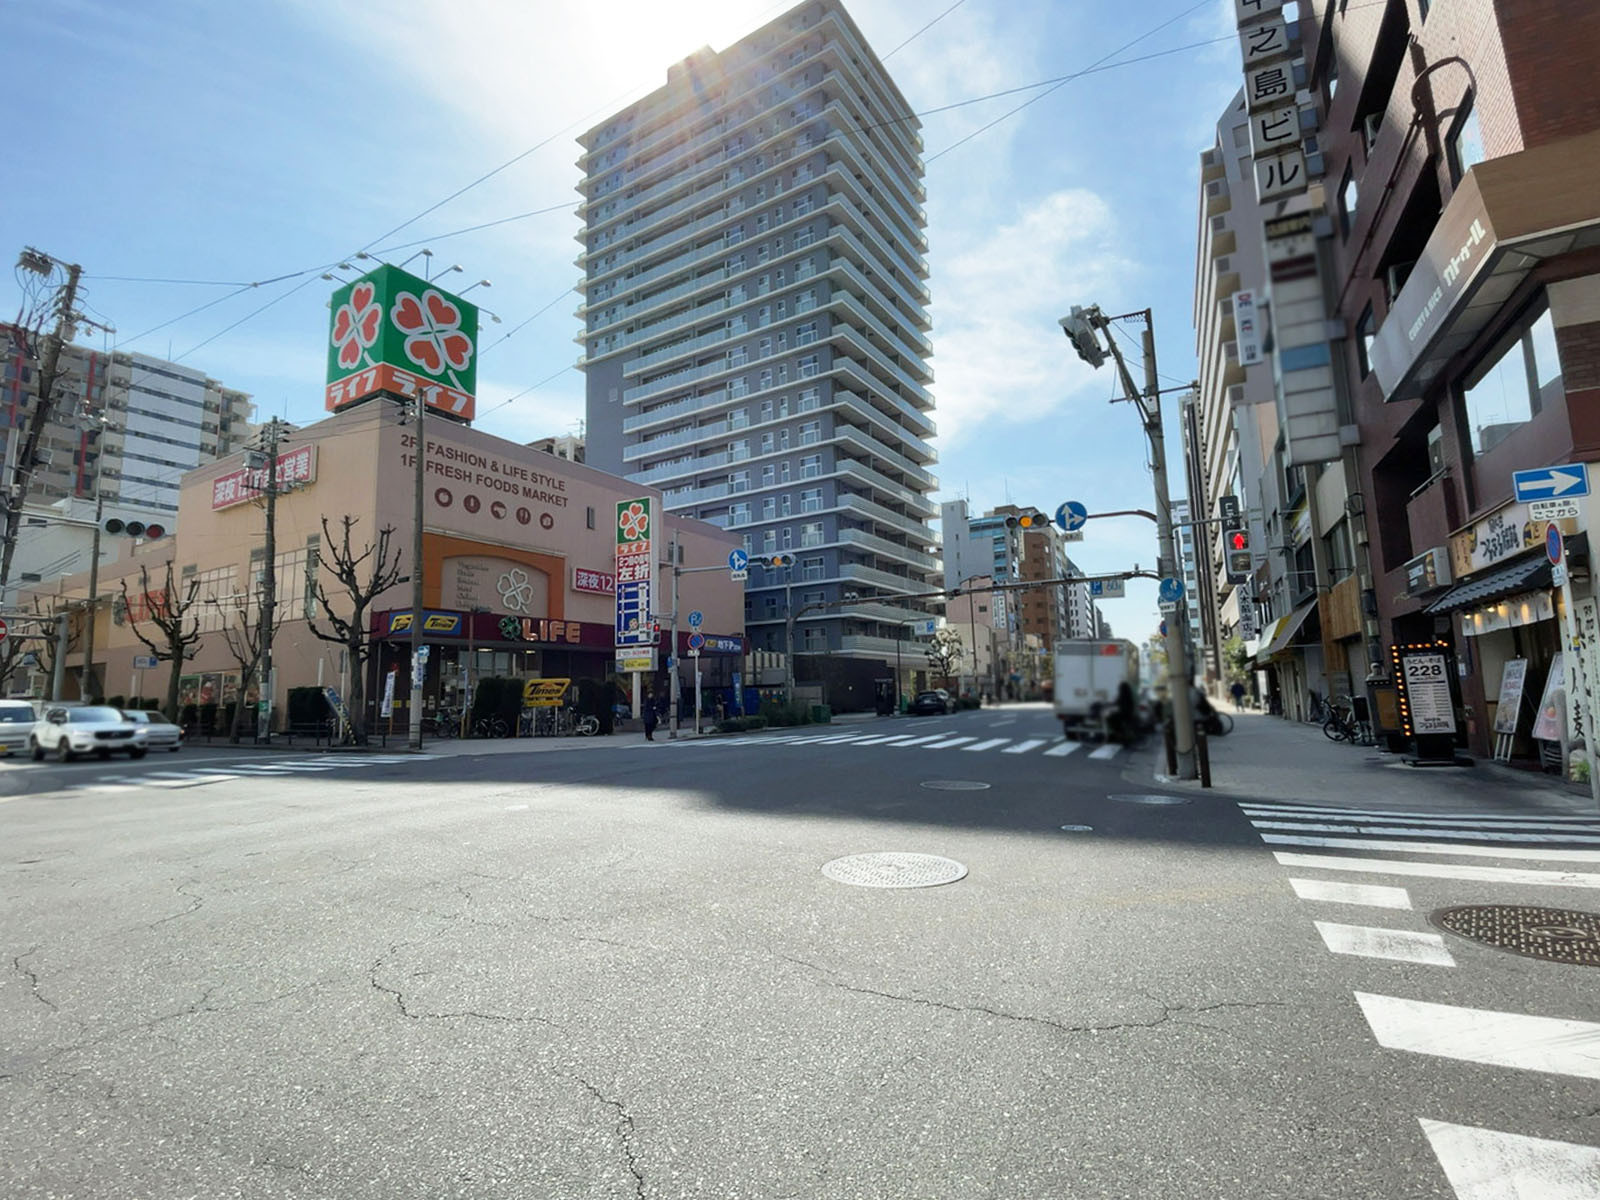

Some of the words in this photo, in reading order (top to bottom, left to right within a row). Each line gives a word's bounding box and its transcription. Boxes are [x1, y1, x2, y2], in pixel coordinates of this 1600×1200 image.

[1443, 218, 1486, 287] カトゥール
[330, 369, 377, 404] ライフ
[392, 370, 467, 413] ライフ
[401, 433, 417, 448] 2F
[426, 441, 487, 470] FASHION
[490, 460, 499, 473] &
[502, 463, 528, 481] LIFE
[530, 471, 566, 491] STYLE
[401, 453, 417, 467] 1F
[426, 460, 472, 483] FRESH
[475, 473, 519, 496] FOODS
[522, 486, 568, 508] MARKET
[1534, 507, 1578, 520] ここから
[619, 541, 649, 554] ライフ
[618, 565, 649, 582] 左折
[522, 618, 581, 644] LIFE
[1408, 664, 1442, 677] 228
[529, 682, 565, 697] Times
